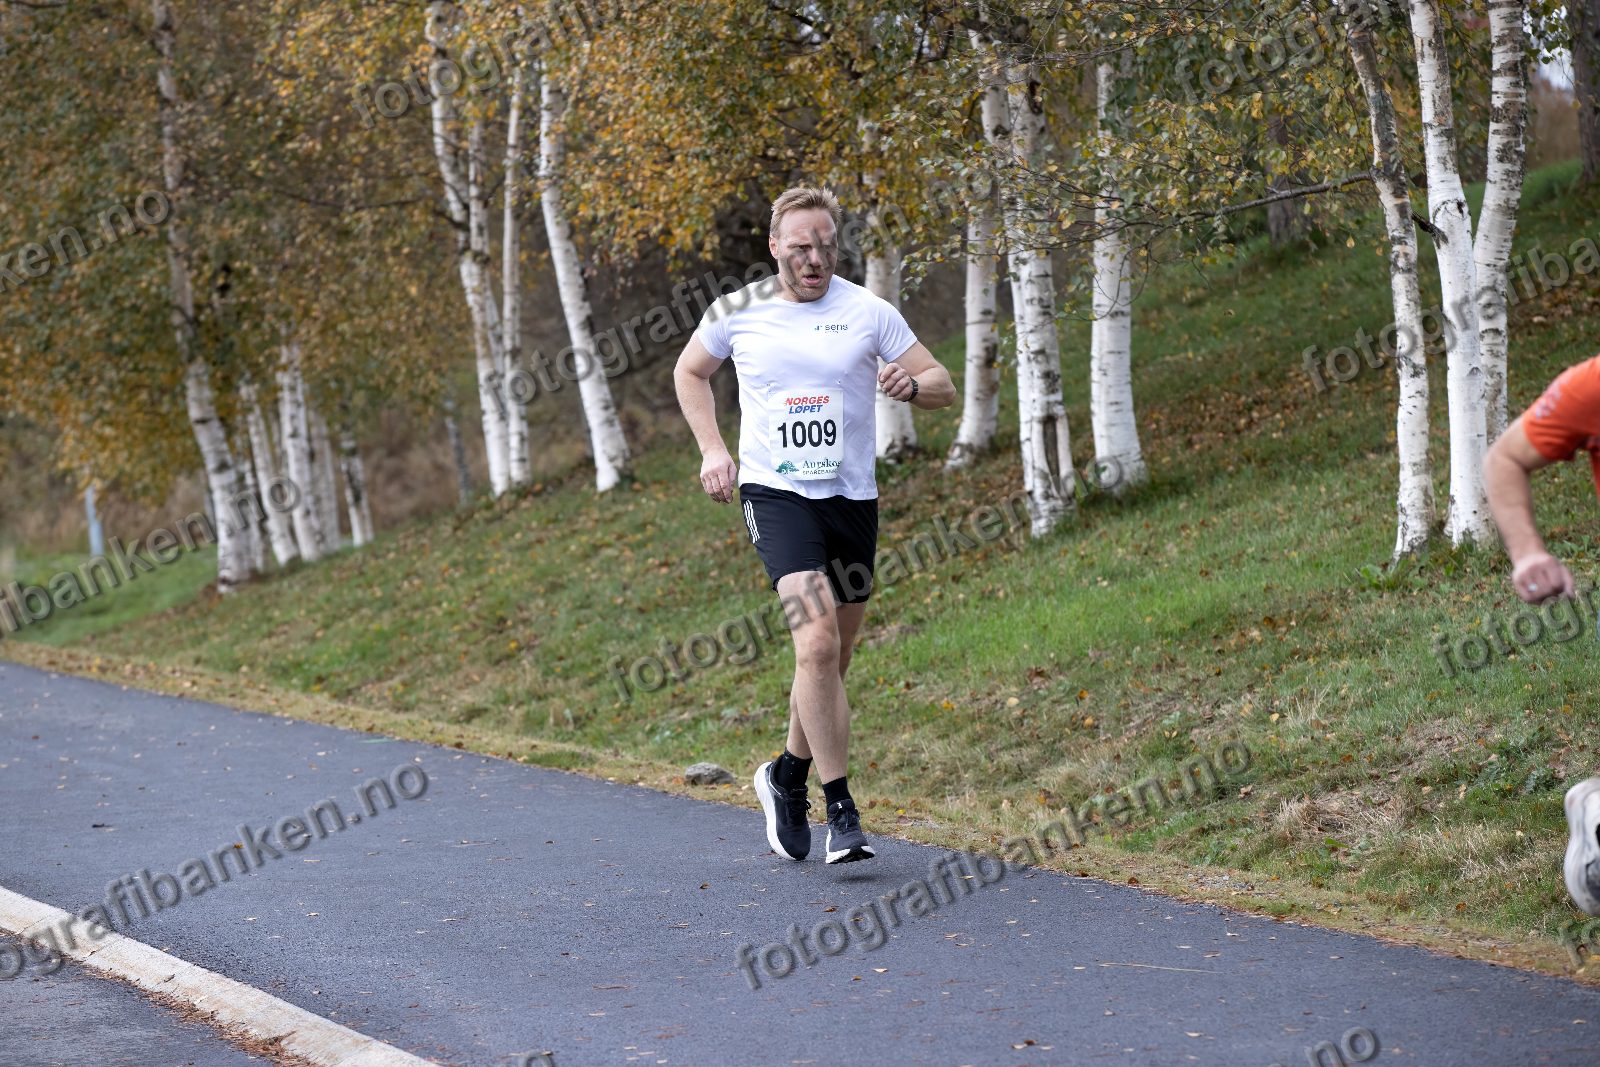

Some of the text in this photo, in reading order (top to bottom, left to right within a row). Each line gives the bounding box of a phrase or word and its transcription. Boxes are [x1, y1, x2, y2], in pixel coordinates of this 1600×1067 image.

[784, 395, 830, 406] NORGES
[788, 404, 823, 415] LØPET
[777, 419, 837, 448] 1009
